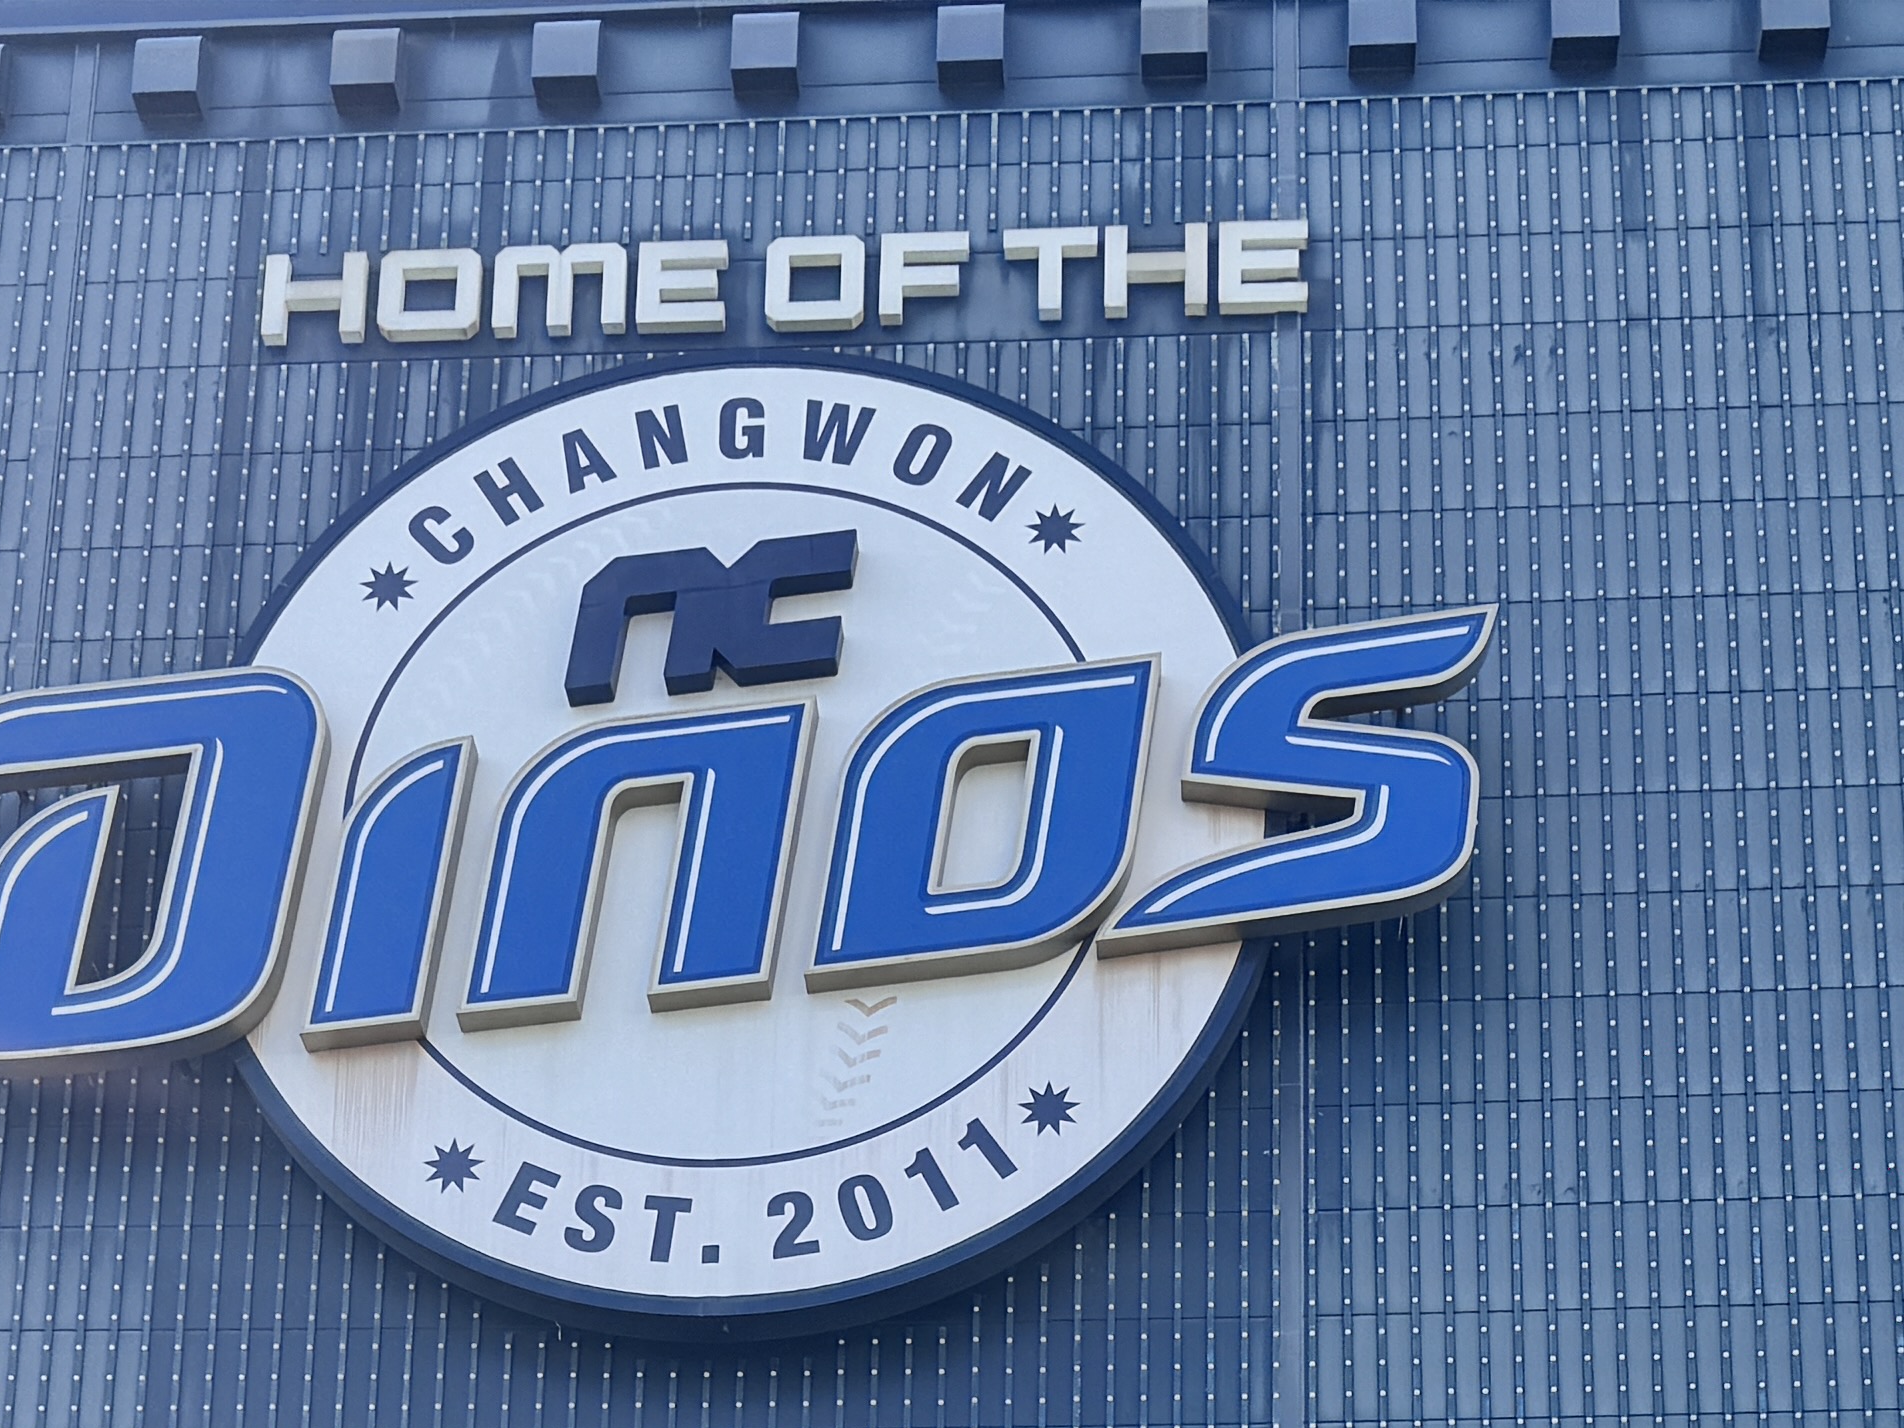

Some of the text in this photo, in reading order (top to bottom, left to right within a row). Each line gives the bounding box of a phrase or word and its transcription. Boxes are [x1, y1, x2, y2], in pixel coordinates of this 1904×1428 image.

[260, 217, 1312, 347] HOME OF THE
[406, 396, 1034, 568] CHANGWON
[492, 1115, 1025, 1268] EST. 2011
